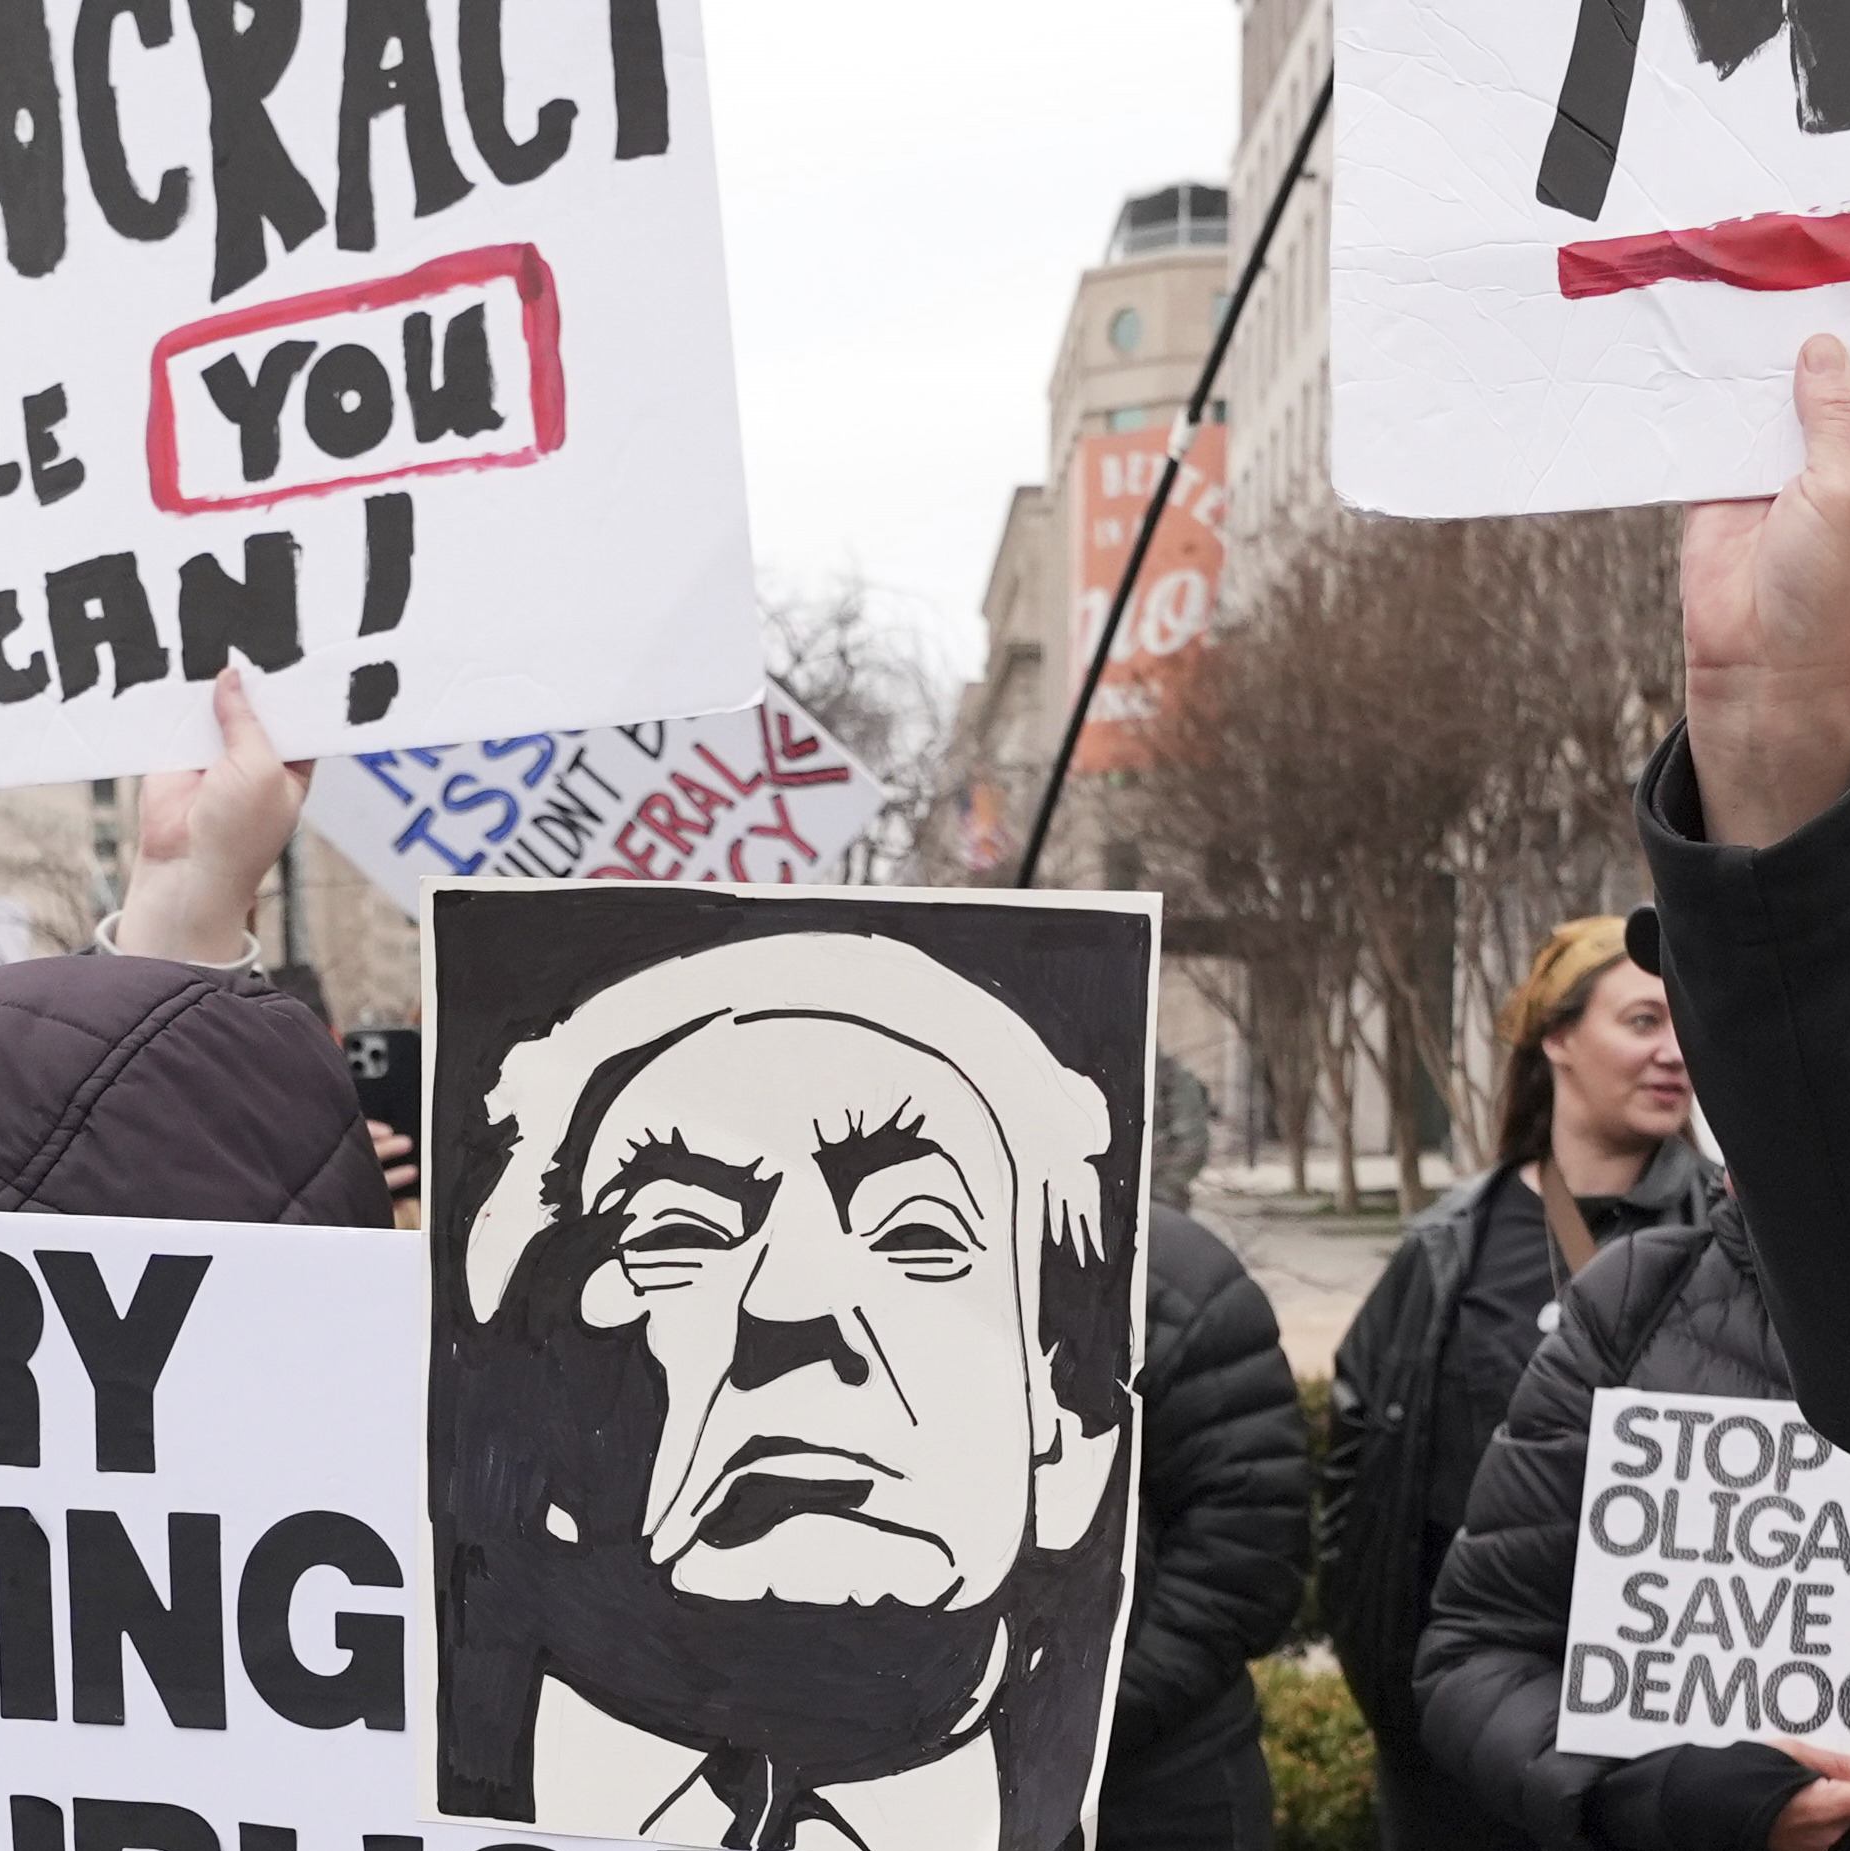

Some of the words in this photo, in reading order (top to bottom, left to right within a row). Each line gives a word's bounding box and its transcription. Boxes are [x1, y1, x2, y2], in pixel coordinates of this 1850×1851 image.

[201, 304, 504, 482] YOU
[1611, 1406, 1833, 1493] STOP
[1617, 1571, 1835, 1655] SAVE
